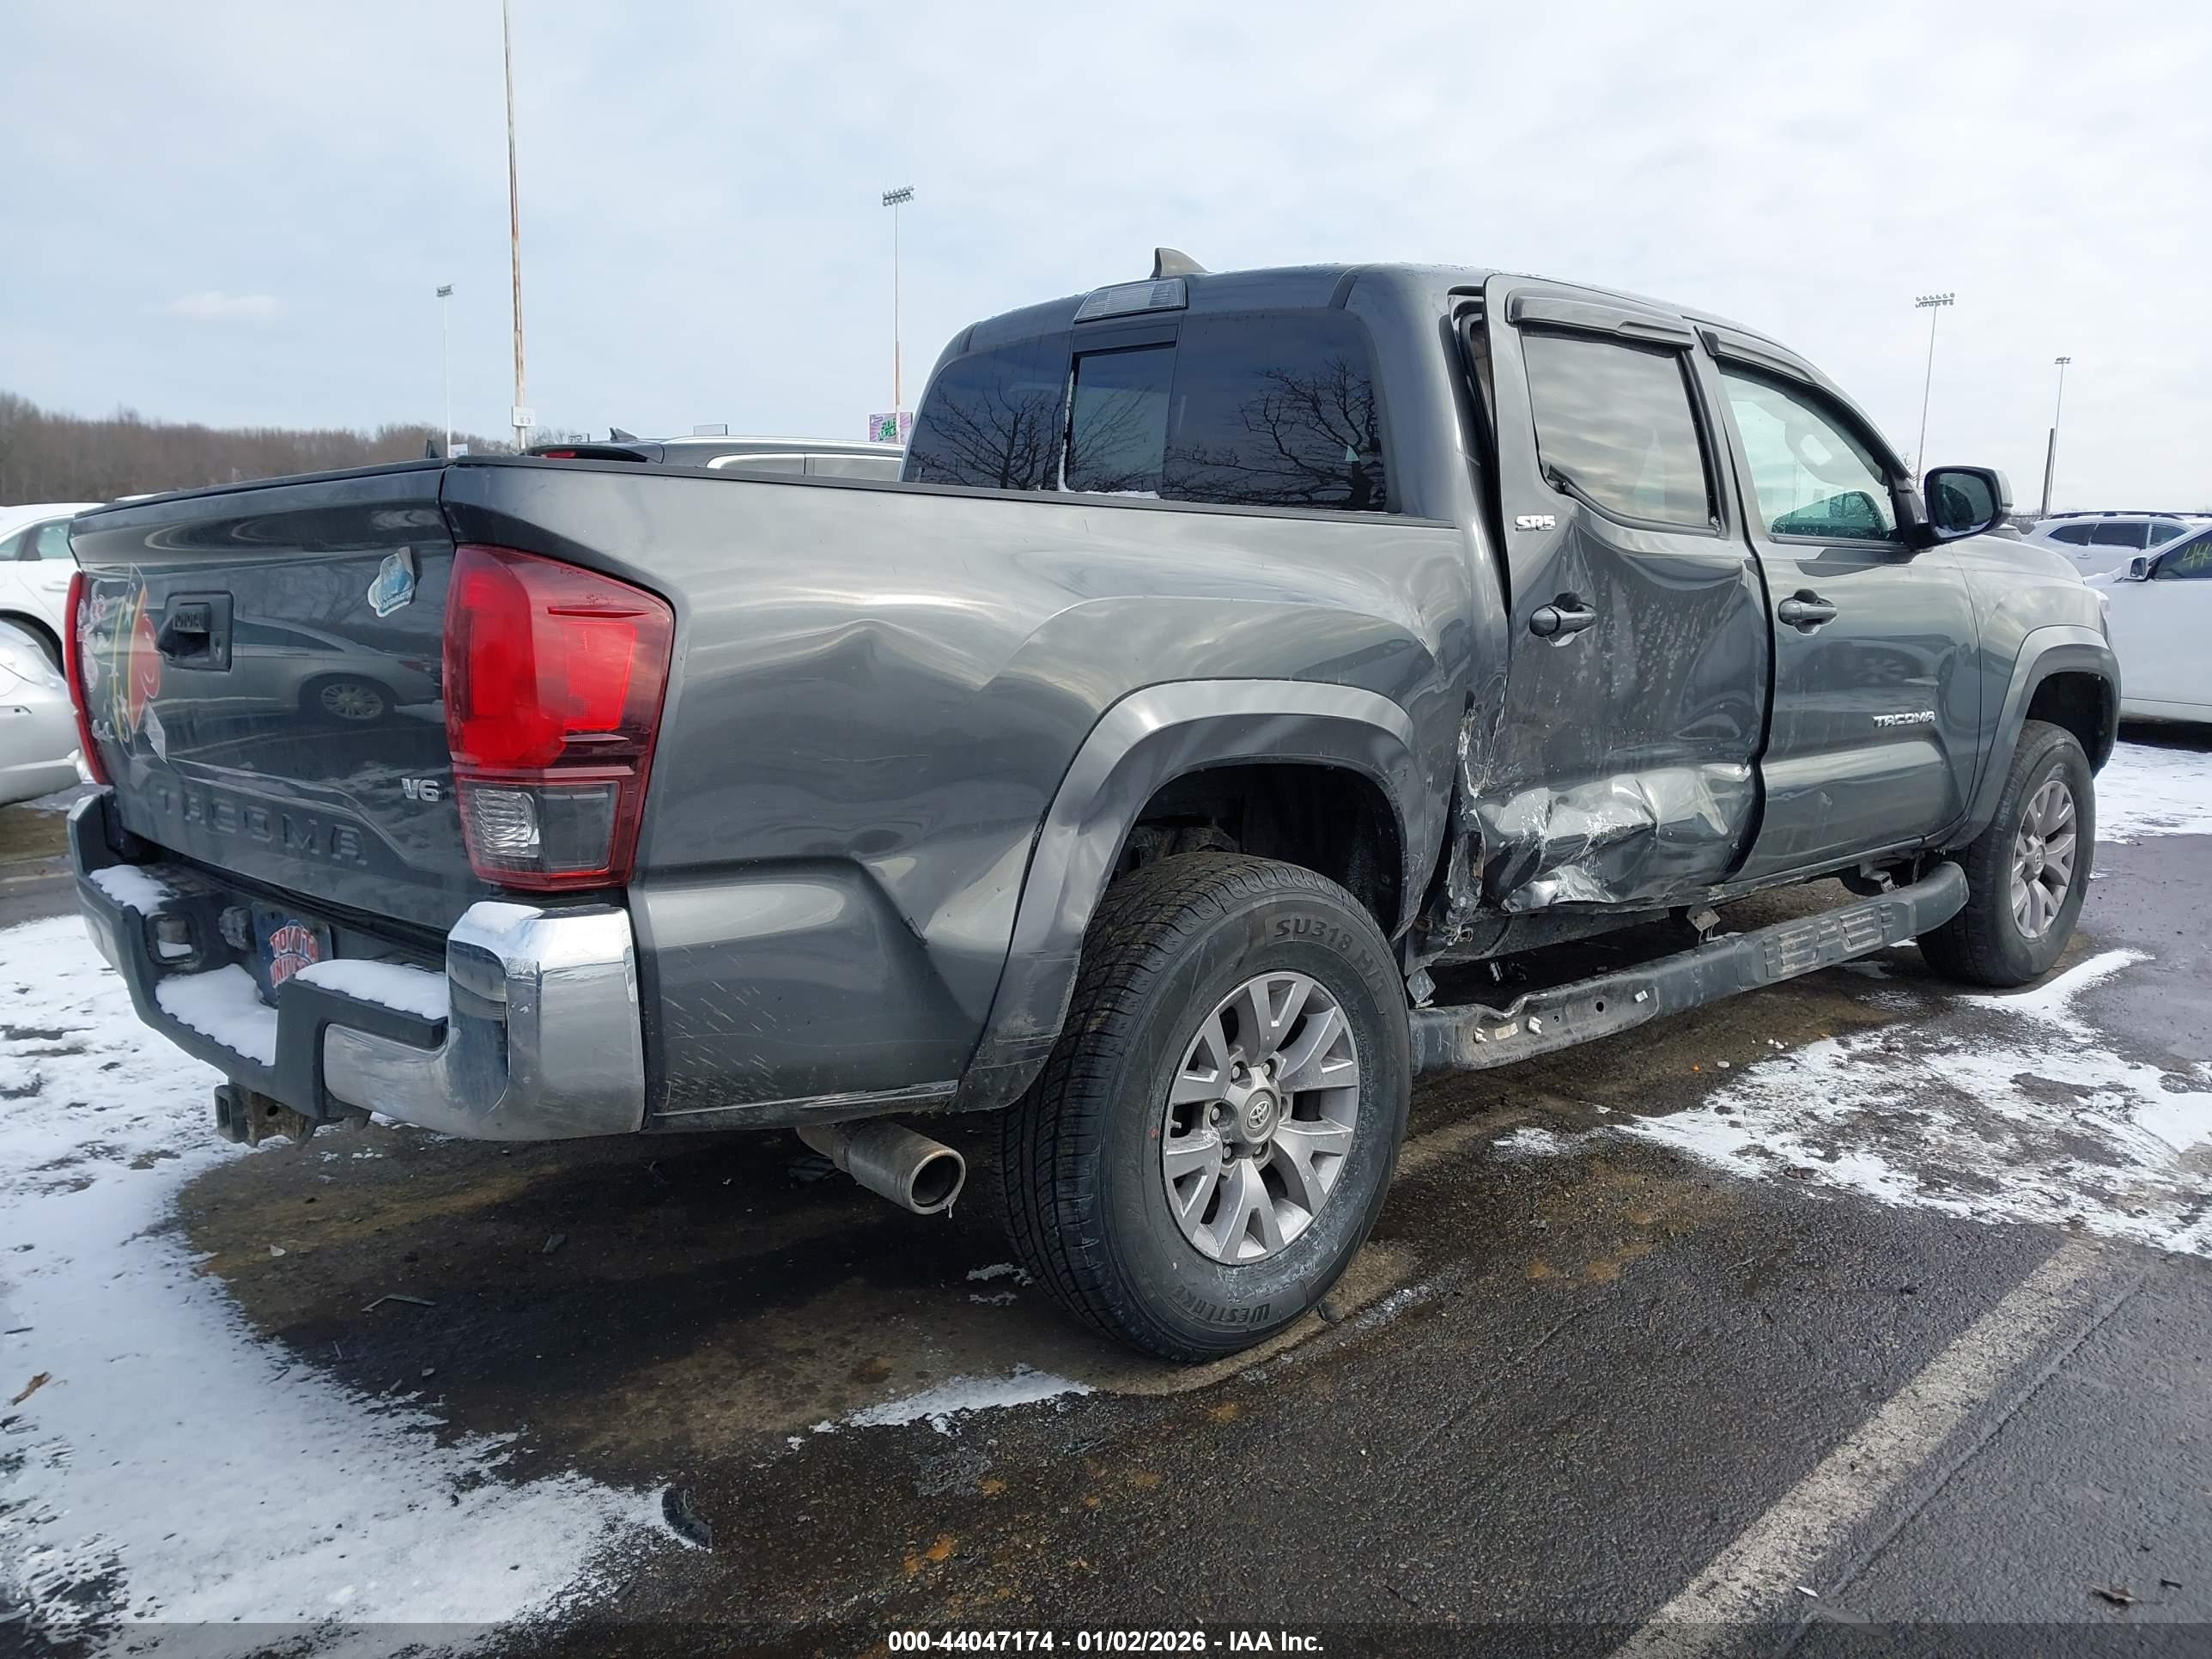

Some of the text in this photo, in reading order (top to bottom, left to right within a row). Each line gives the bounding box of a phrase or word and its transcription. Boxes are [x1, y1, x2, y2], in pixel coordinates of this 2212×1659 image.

[1515, 514, 1556, 532] SR5
[1872, 710, 1936, 728] TACOMA
[400, 777, 441, 802] V6
[156, 780, 369, 866] TACOMA
[269, 926, 318, 963] TOYOTA
[1274, 915, 1353, 952] SU318
[1169, 1284, 1271, 1324] WESTLAKE
